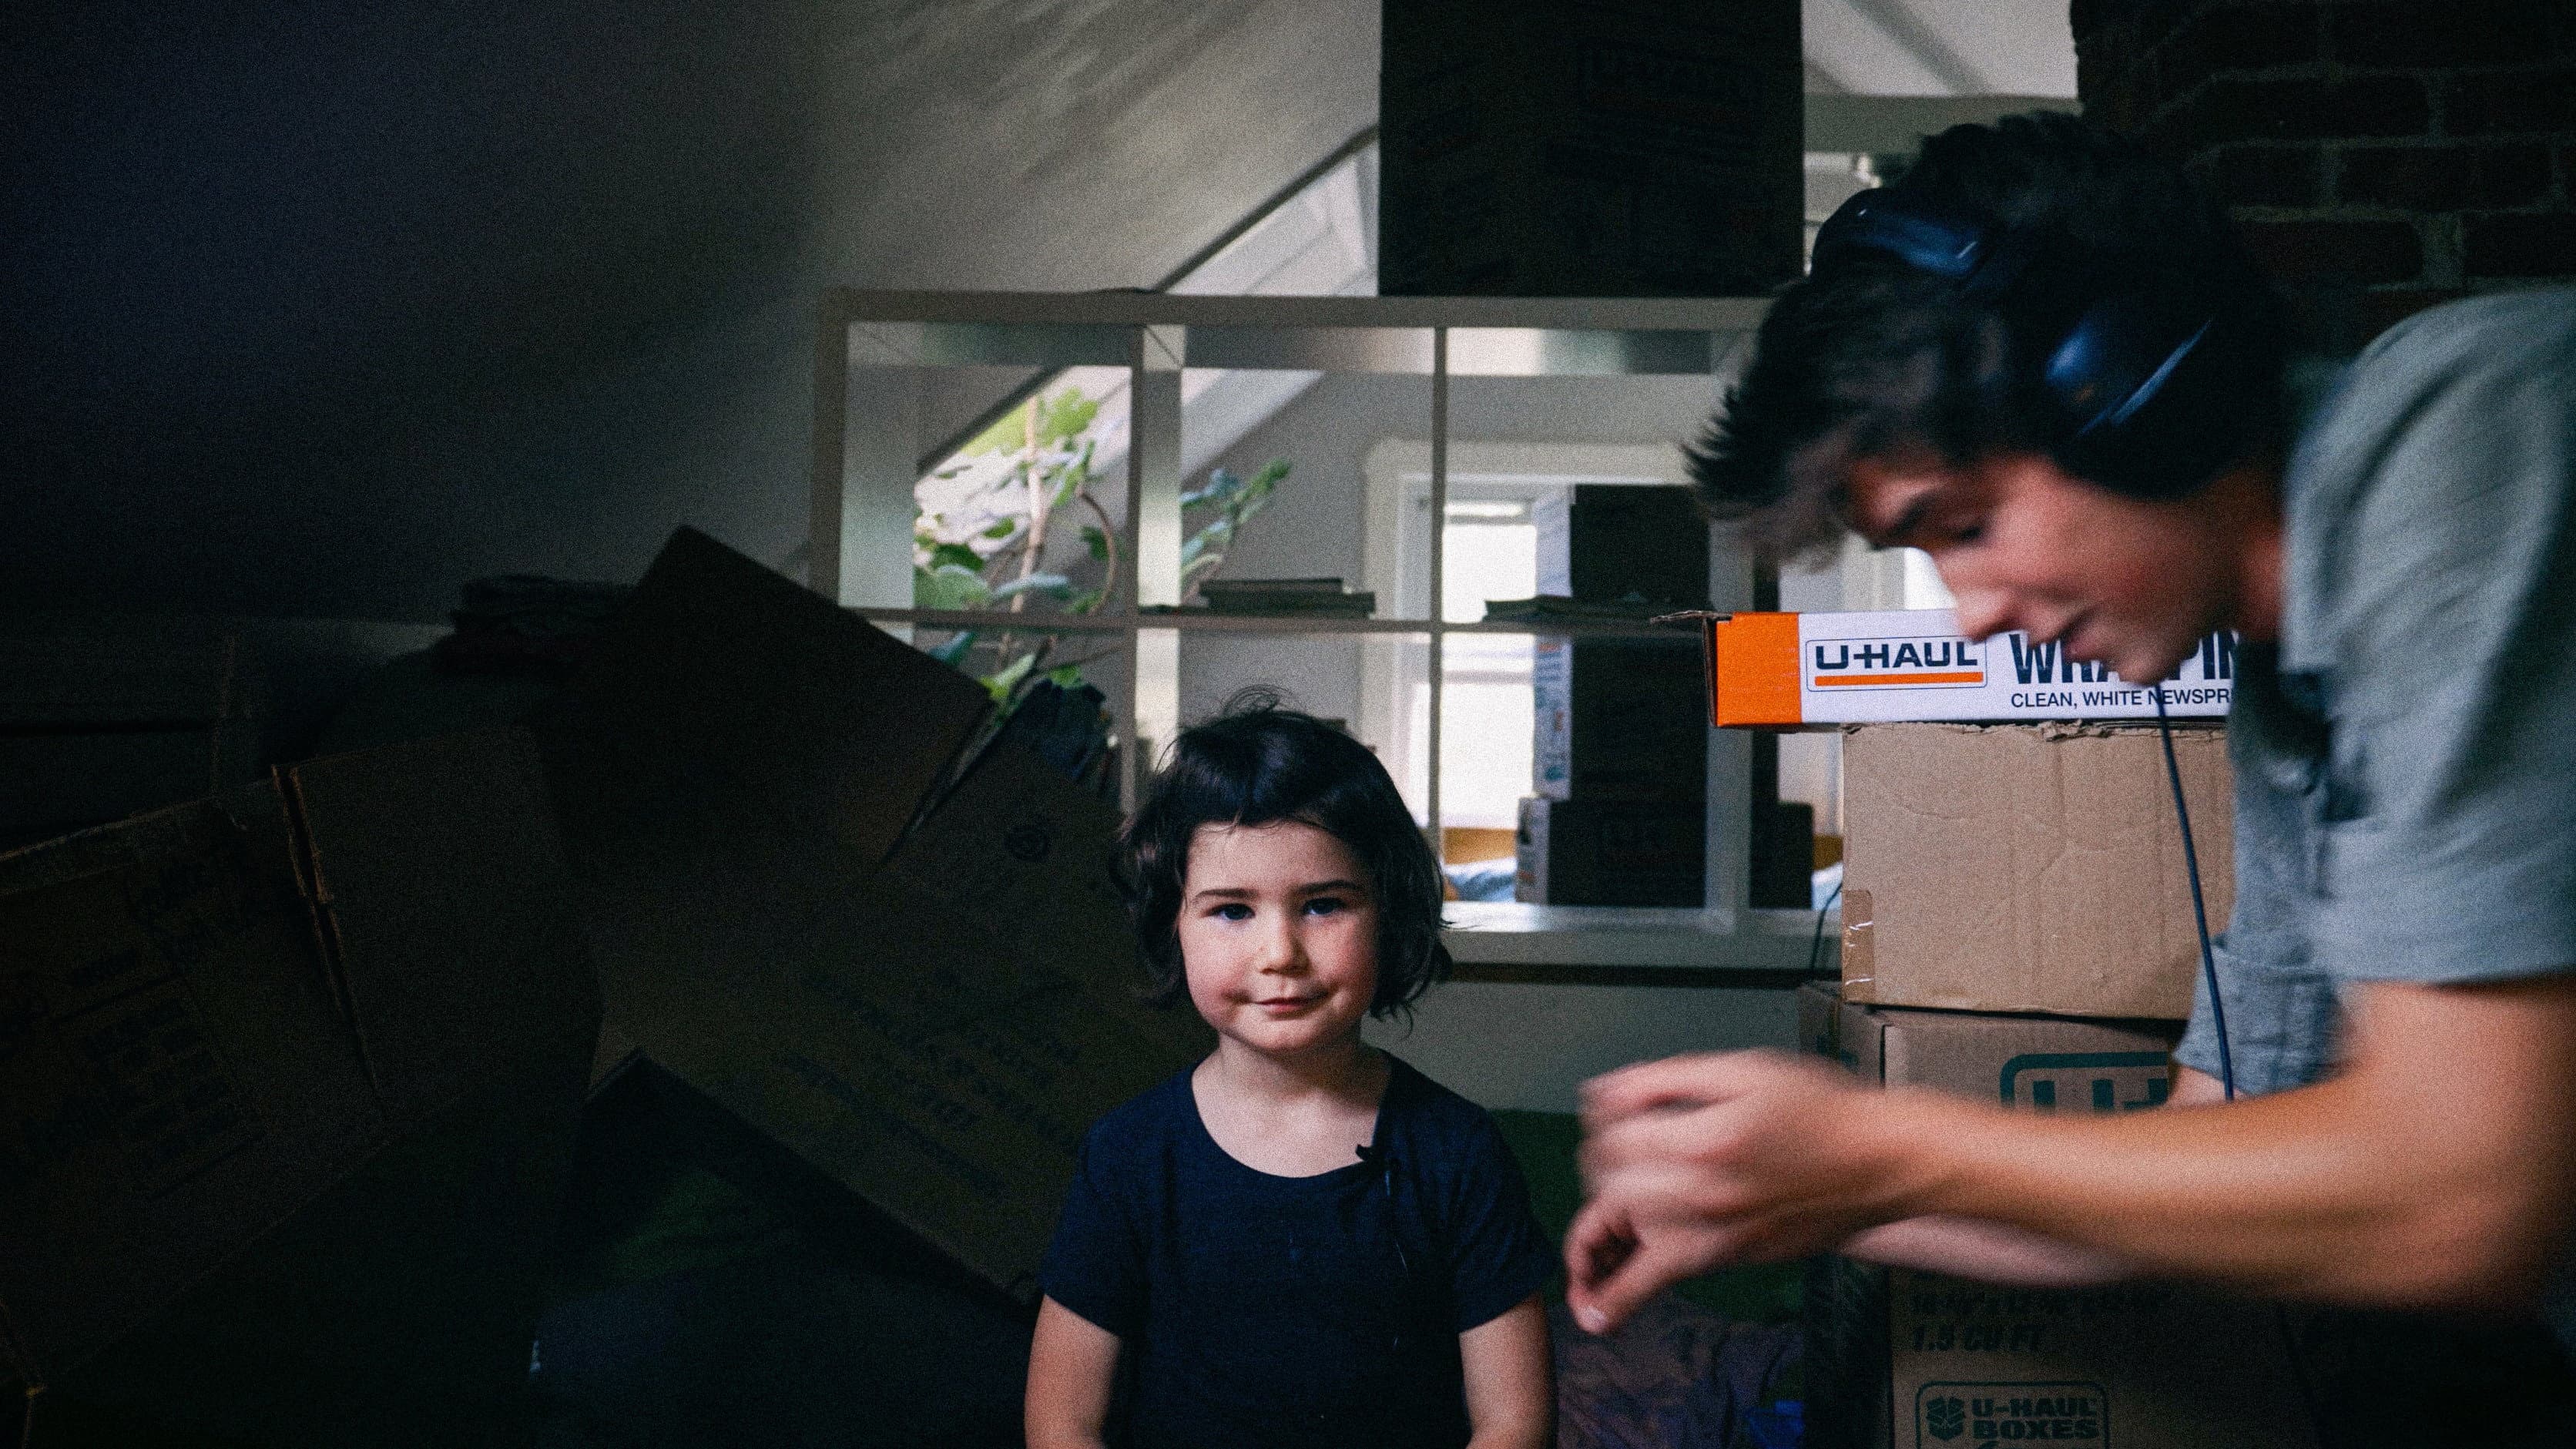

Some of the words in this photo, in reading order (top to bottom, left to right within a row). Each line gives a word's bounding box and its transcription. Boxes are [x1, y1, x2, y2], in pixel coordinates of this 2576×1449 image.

[1815, 641, 1978, 670] U-HAUL
[2011, 692, 2078, 709] CLEAN,
[2082, 690, 2142, 706] WHITE
[1971, 1397, 2097, 1417] U-HAUL
[1973, 1419, 2100, 1440] BOXES
